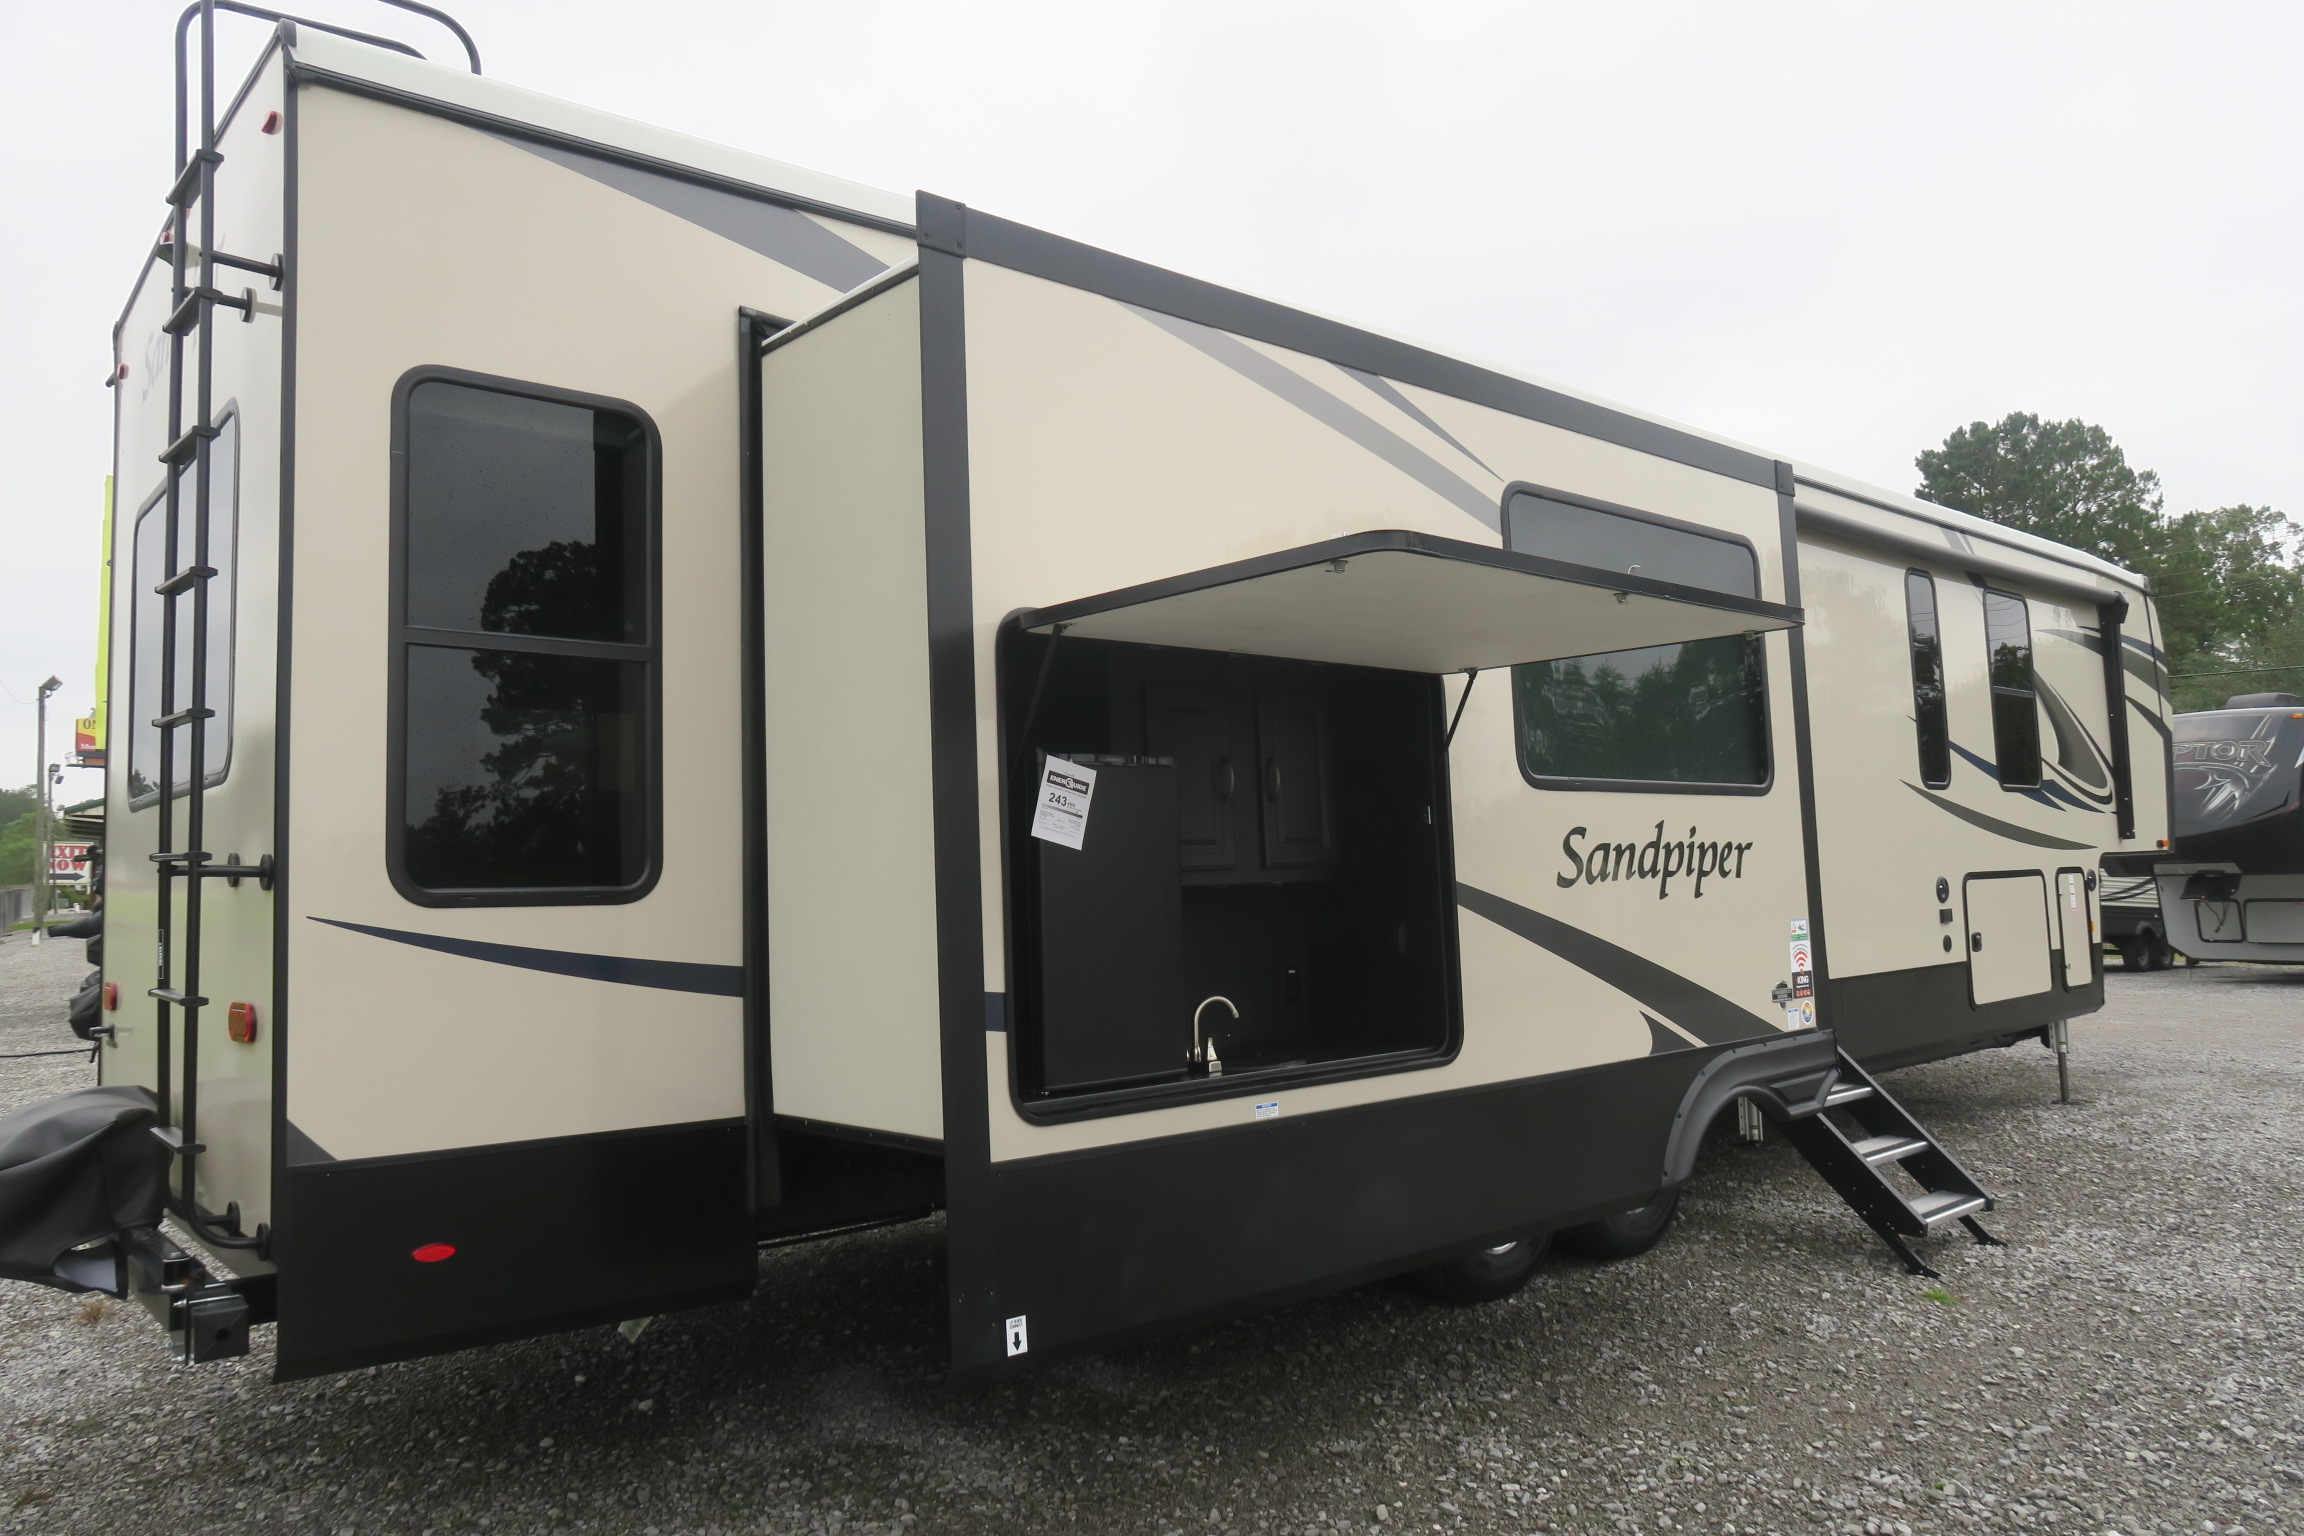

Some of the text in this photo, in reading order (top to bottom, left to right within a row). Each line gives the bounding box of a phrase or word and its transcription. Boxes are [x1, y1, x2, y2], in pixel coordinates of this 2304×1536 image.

[1049, 775, 1087, 791] ENERGUIDE
[1048, 792, 1067, 807] 243
[1556, 819, 1754, 900] Sandpiper
[1796, 975, 1810, 984] KING
